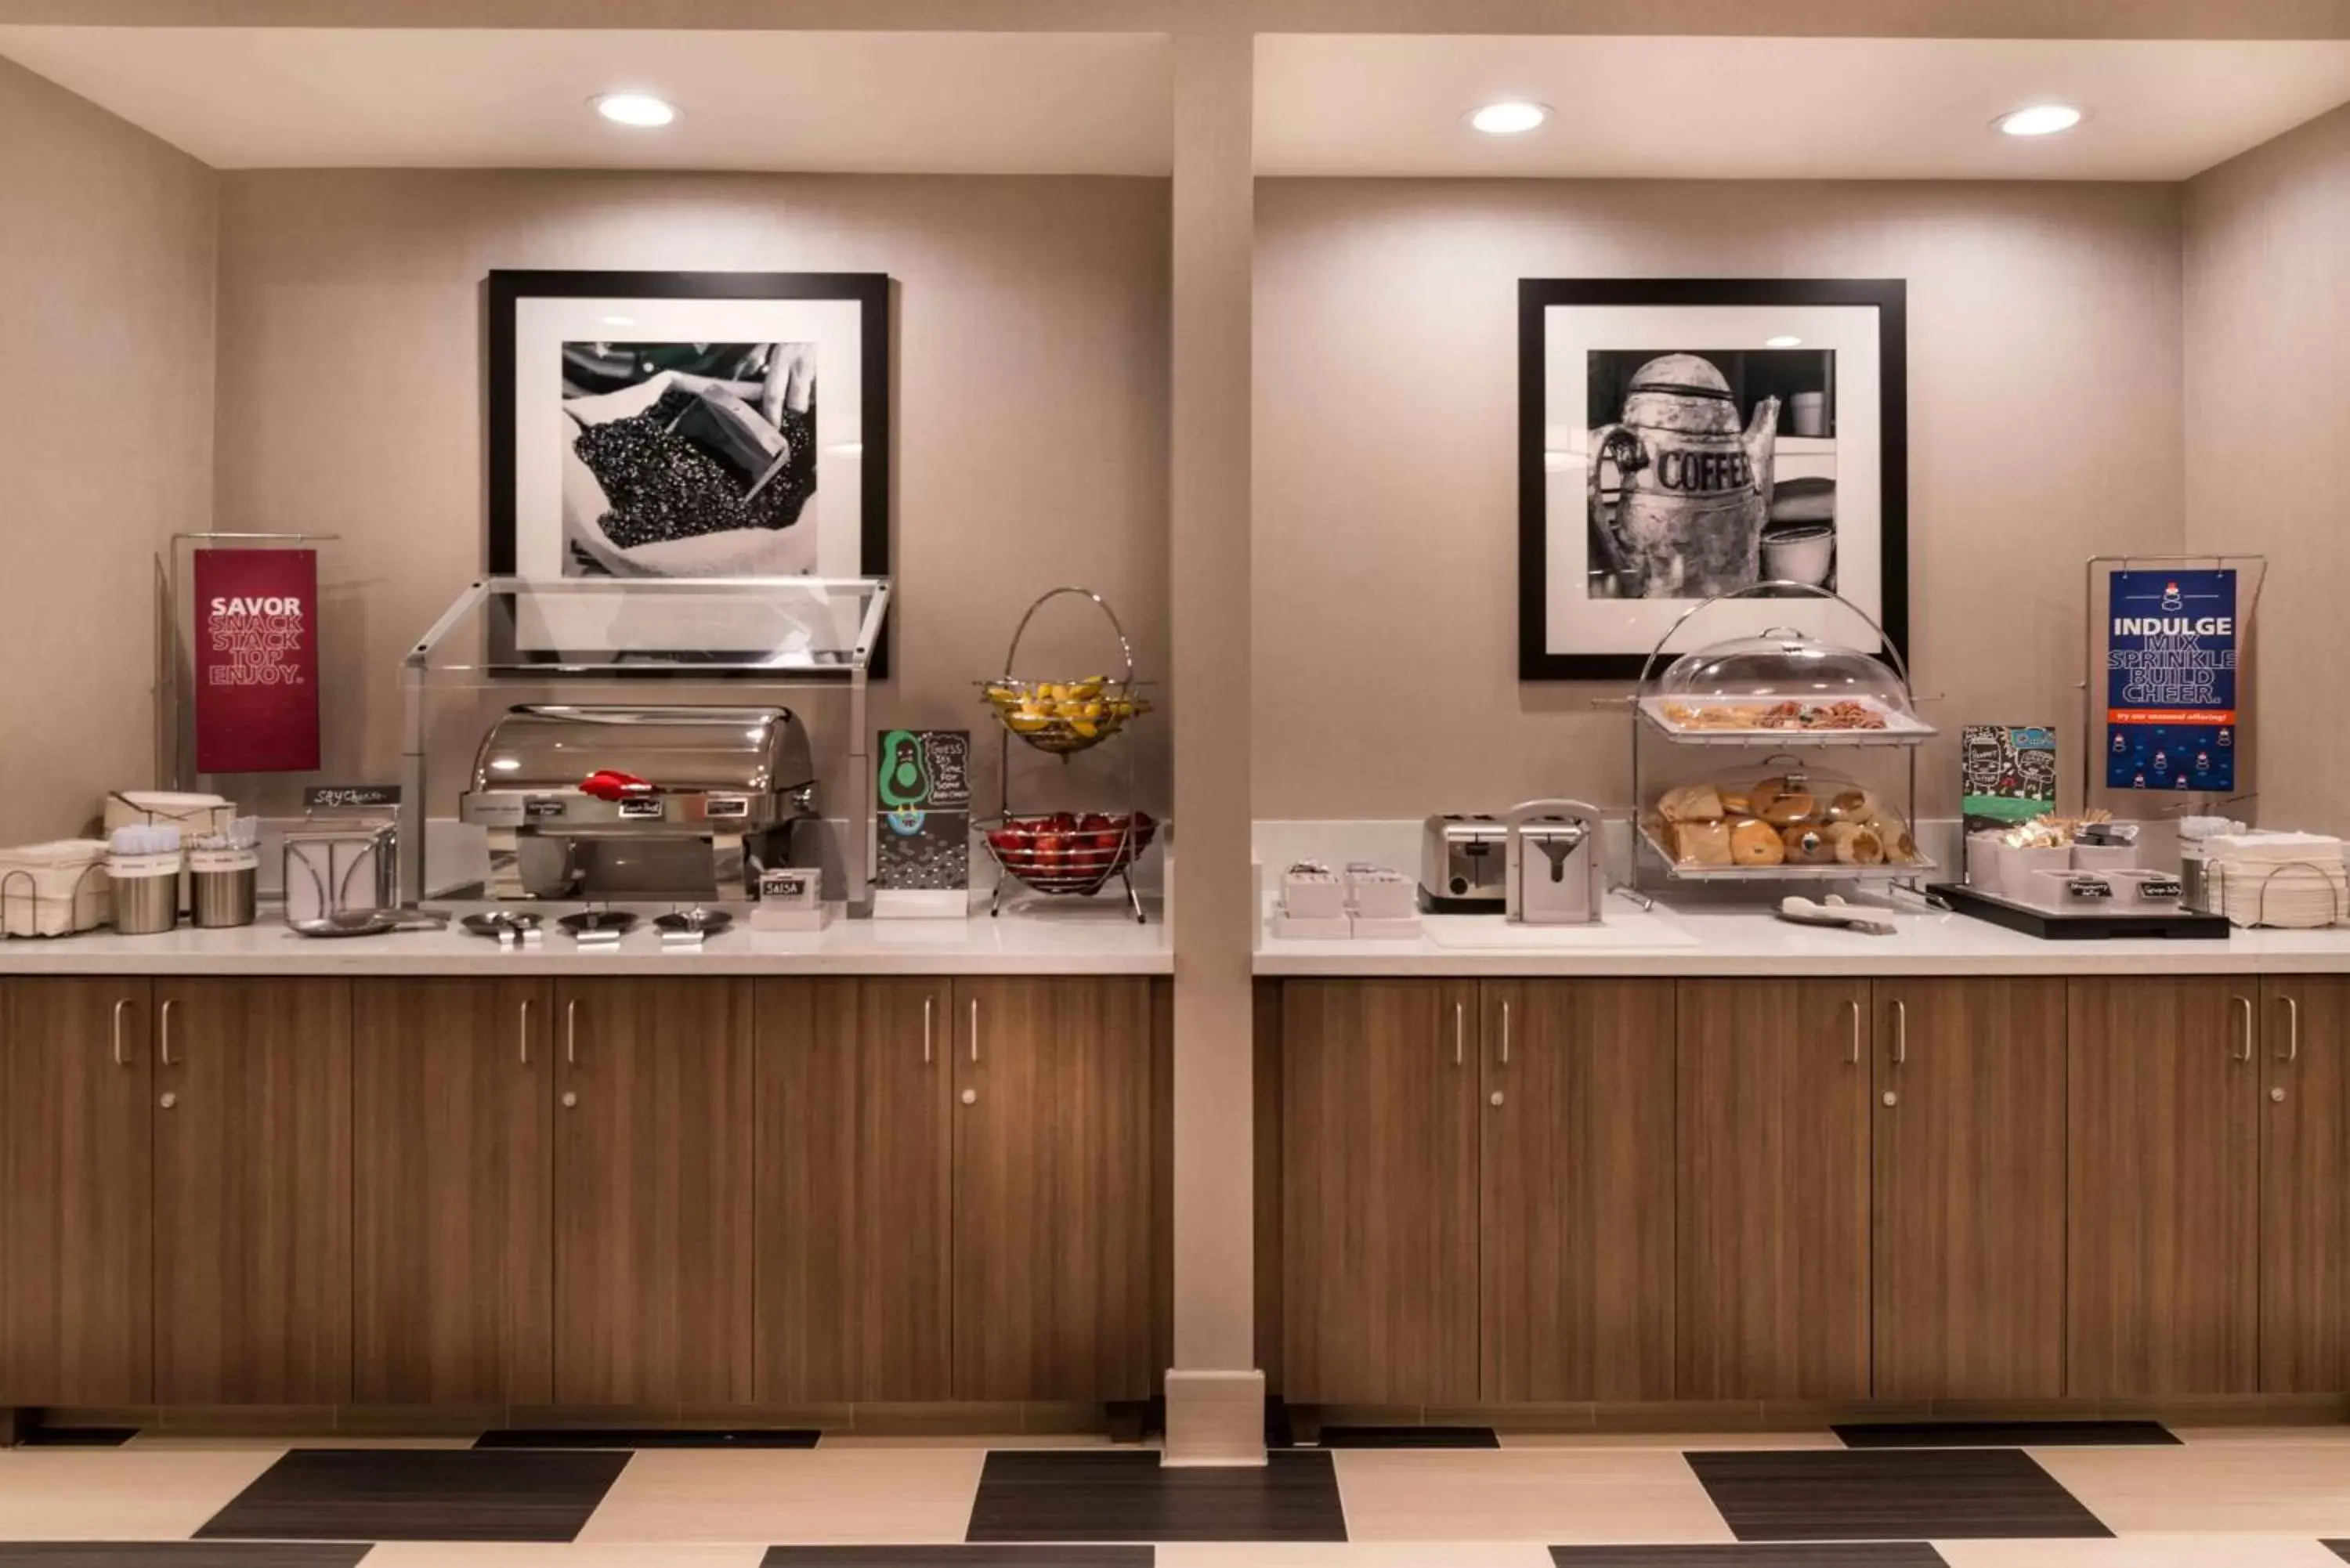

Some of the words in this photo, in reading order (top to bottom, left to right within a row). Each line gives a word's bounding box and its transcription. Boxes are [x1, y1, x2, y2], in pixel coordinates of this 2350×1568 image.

[1658, 449, 1751, 490] COFFEE
[211, 597, 302, 616] SAVOR
[208, 615, 304, 633] SNACK
[2114, 617, 2232, 635] INDULGE
[212, 631, 301, 651] STACK
[2145, 634, 2199, 652] MIX
[230, 649, 284, 667] TOP
[2108, 649, 2238, 669] SPRINKLE
[2130, 668, 2215, 685] BUILD
[2122, 684, 2222, 703] CHEER.
[766, 883, 798, 894] SALSA
